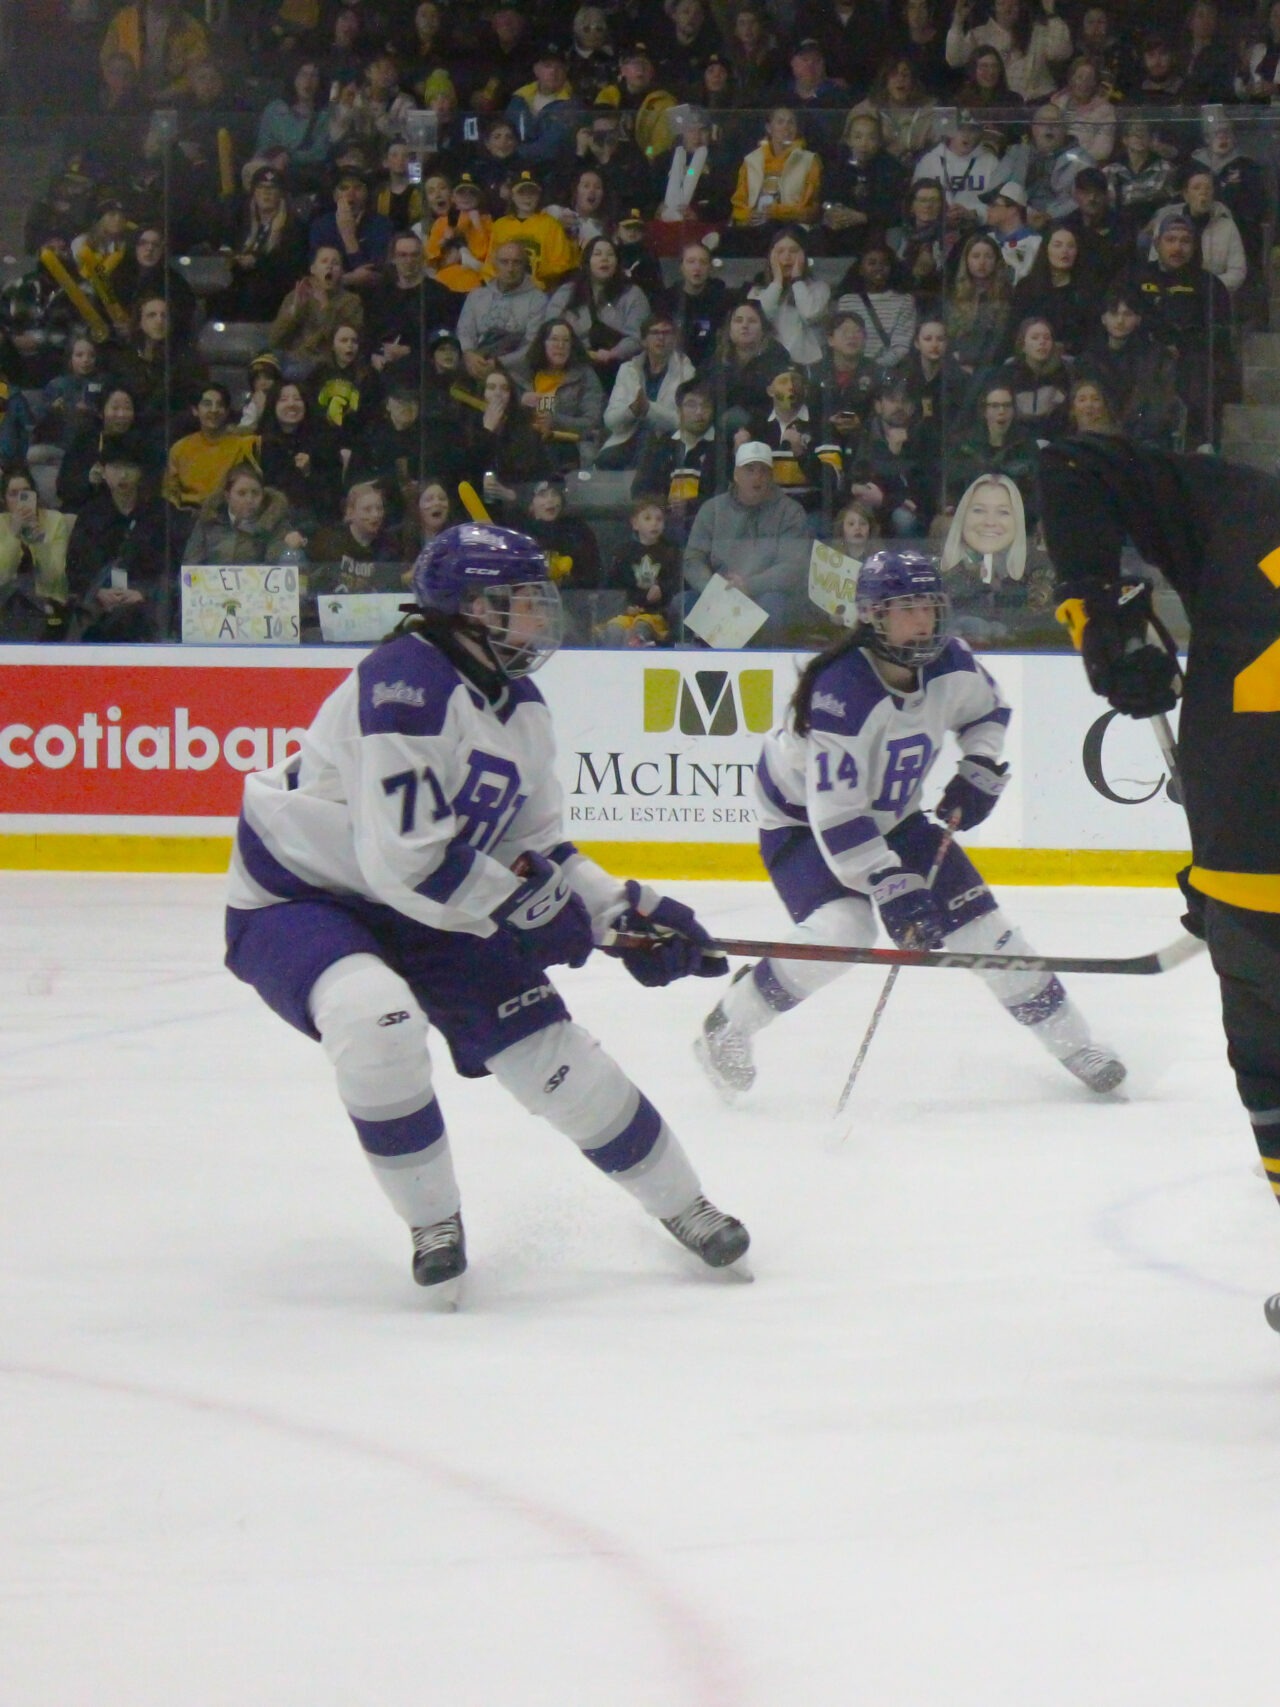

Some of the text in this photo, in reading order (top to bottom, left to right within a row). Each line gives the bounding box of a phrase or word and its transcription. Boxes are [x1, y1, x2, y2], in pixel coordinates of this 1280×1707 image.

[464, 566, 501, 576] CCM
[0, 705, 310, 772] cotiaban
[570, 751, 758, 797] McINT
[815, 751, 859, 792] 14
[381, 765, 452, 835] 71
[570, 806, 623, 821] REAL
[630, 807, 706, 823] ESTATE
[872, 878, 908, 901] CM
